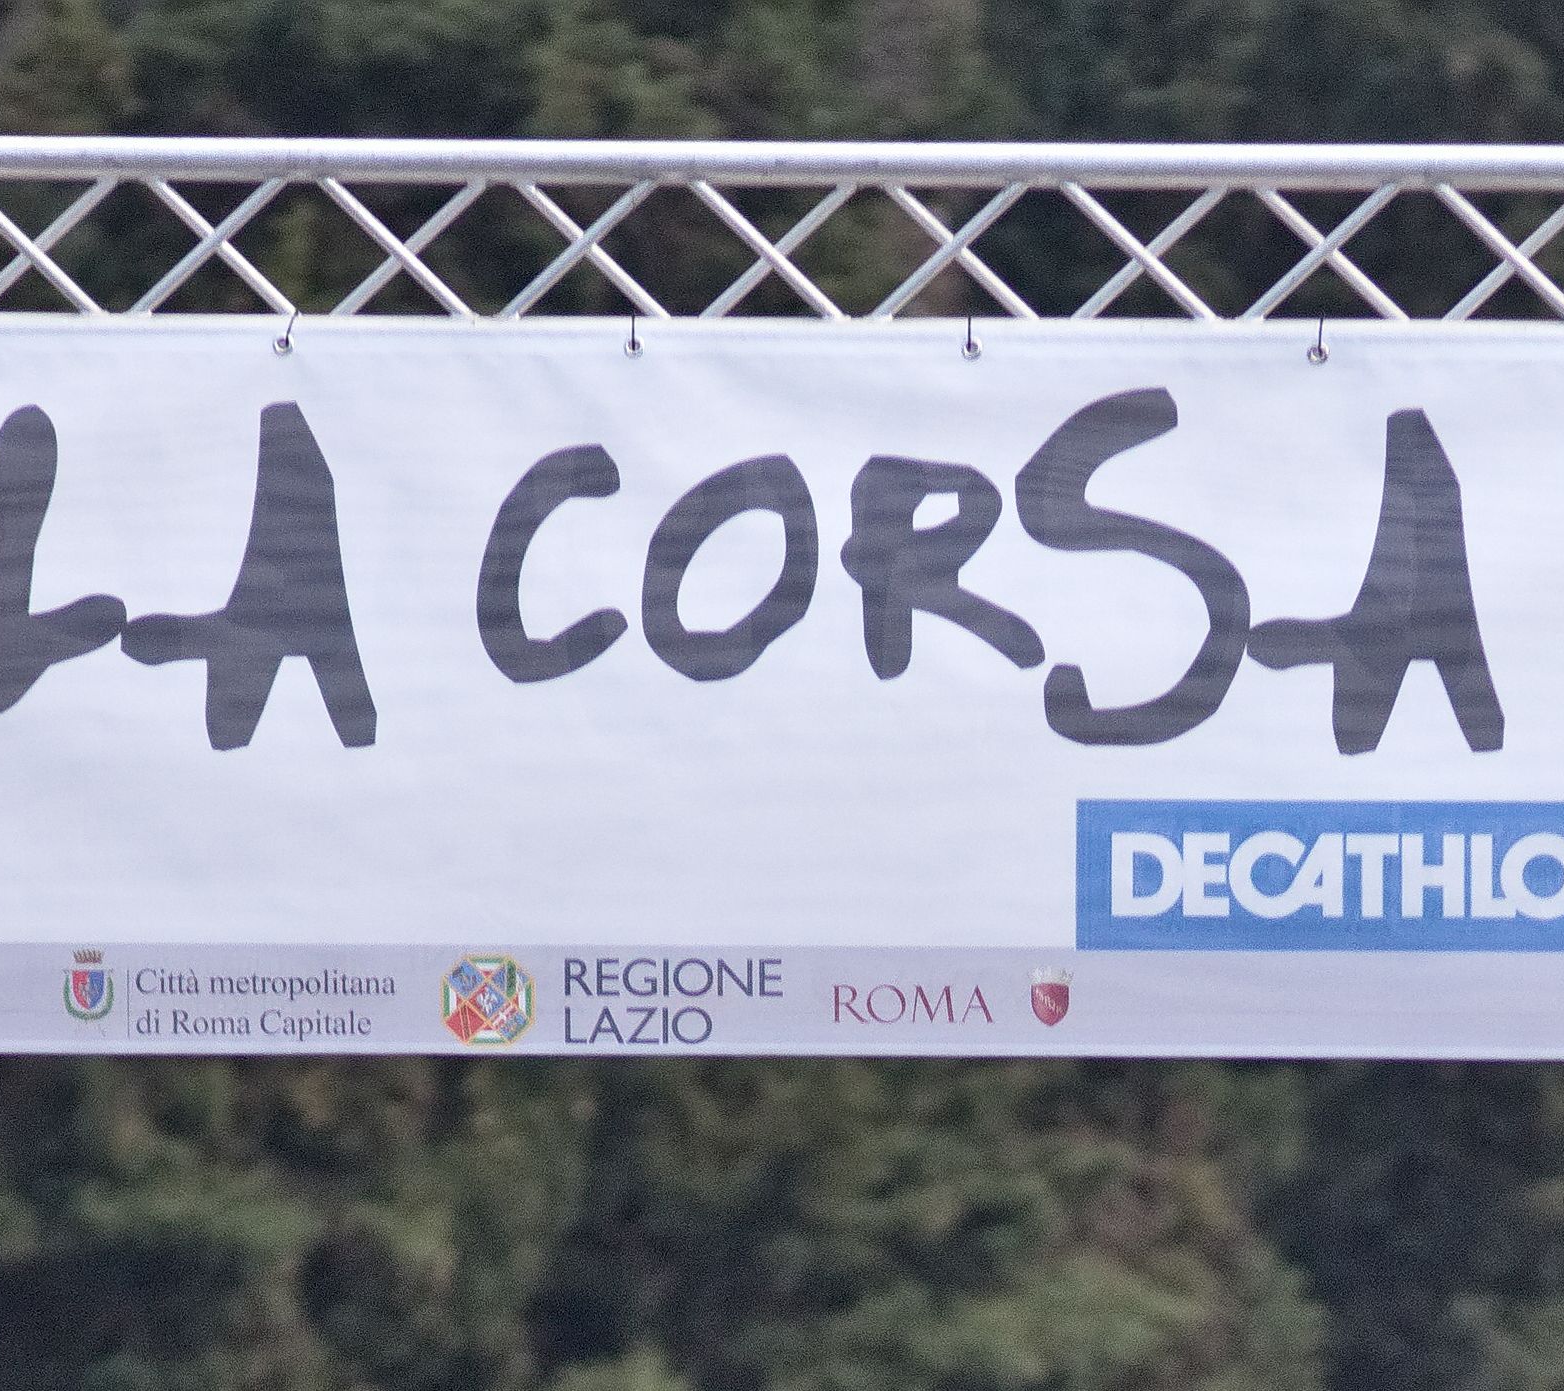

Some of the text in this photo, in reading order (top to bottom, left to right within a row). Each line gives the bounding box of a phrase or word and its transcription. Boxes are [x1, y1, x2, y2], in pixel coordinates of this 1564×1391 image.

[476, 386, 1505, 756] CORSA
[136, 967, 396, 1001] Città metropolitana
[564, 957, 783, 998] REGIONE
[833, 983, 994, 1024] ROMA
[136, 1008, 372, 1041] di Roma Capitale
[564, 1006, 713, 1045] LAZIO
